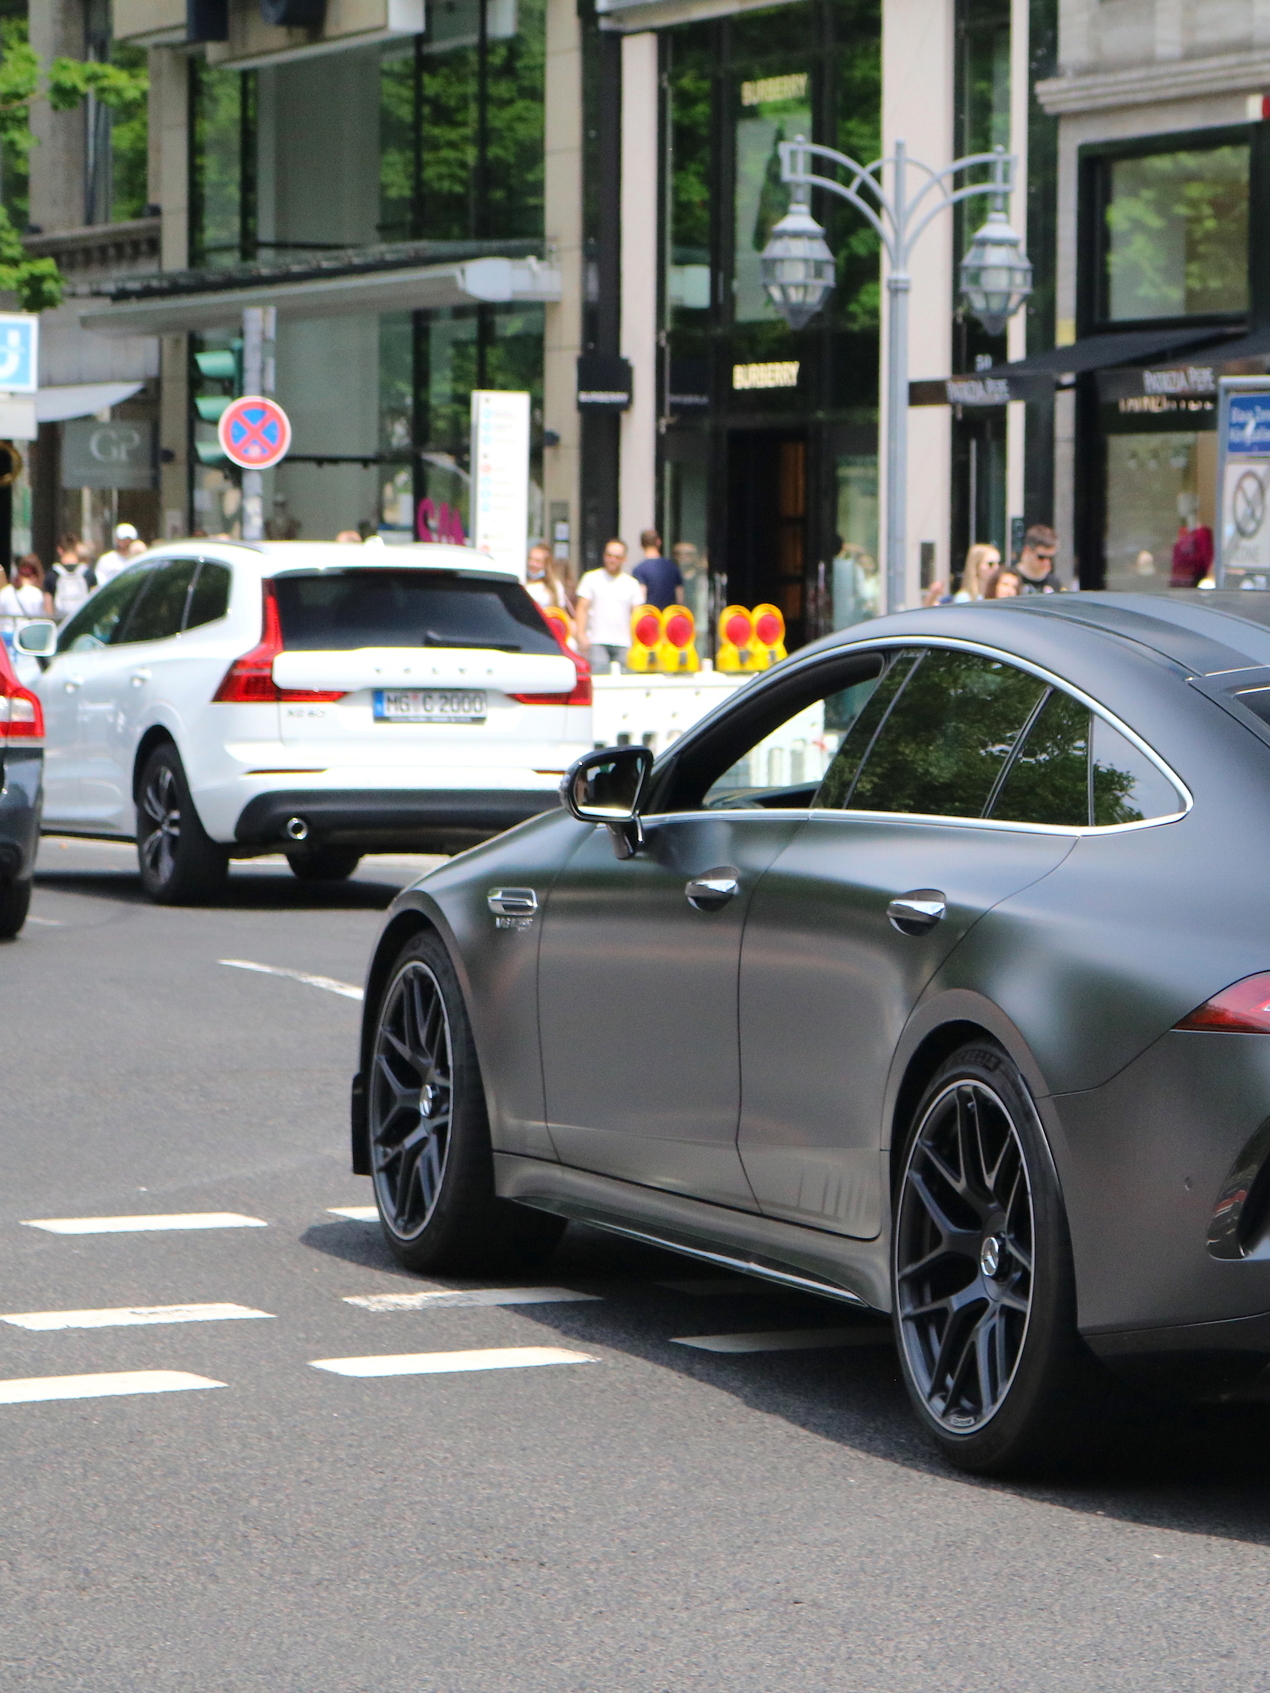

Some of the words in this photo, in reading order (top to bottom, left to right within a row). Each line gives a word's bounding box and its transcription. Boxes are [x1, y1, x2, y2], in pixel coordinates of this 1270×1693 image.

[732, 361, 800, 389] BURBERRY
[90, 428, 140, 462] GP
[386, 691, 410, 713] MG
[423, 691, 434, 713] C
[439, 691, 484, 714] 2000
